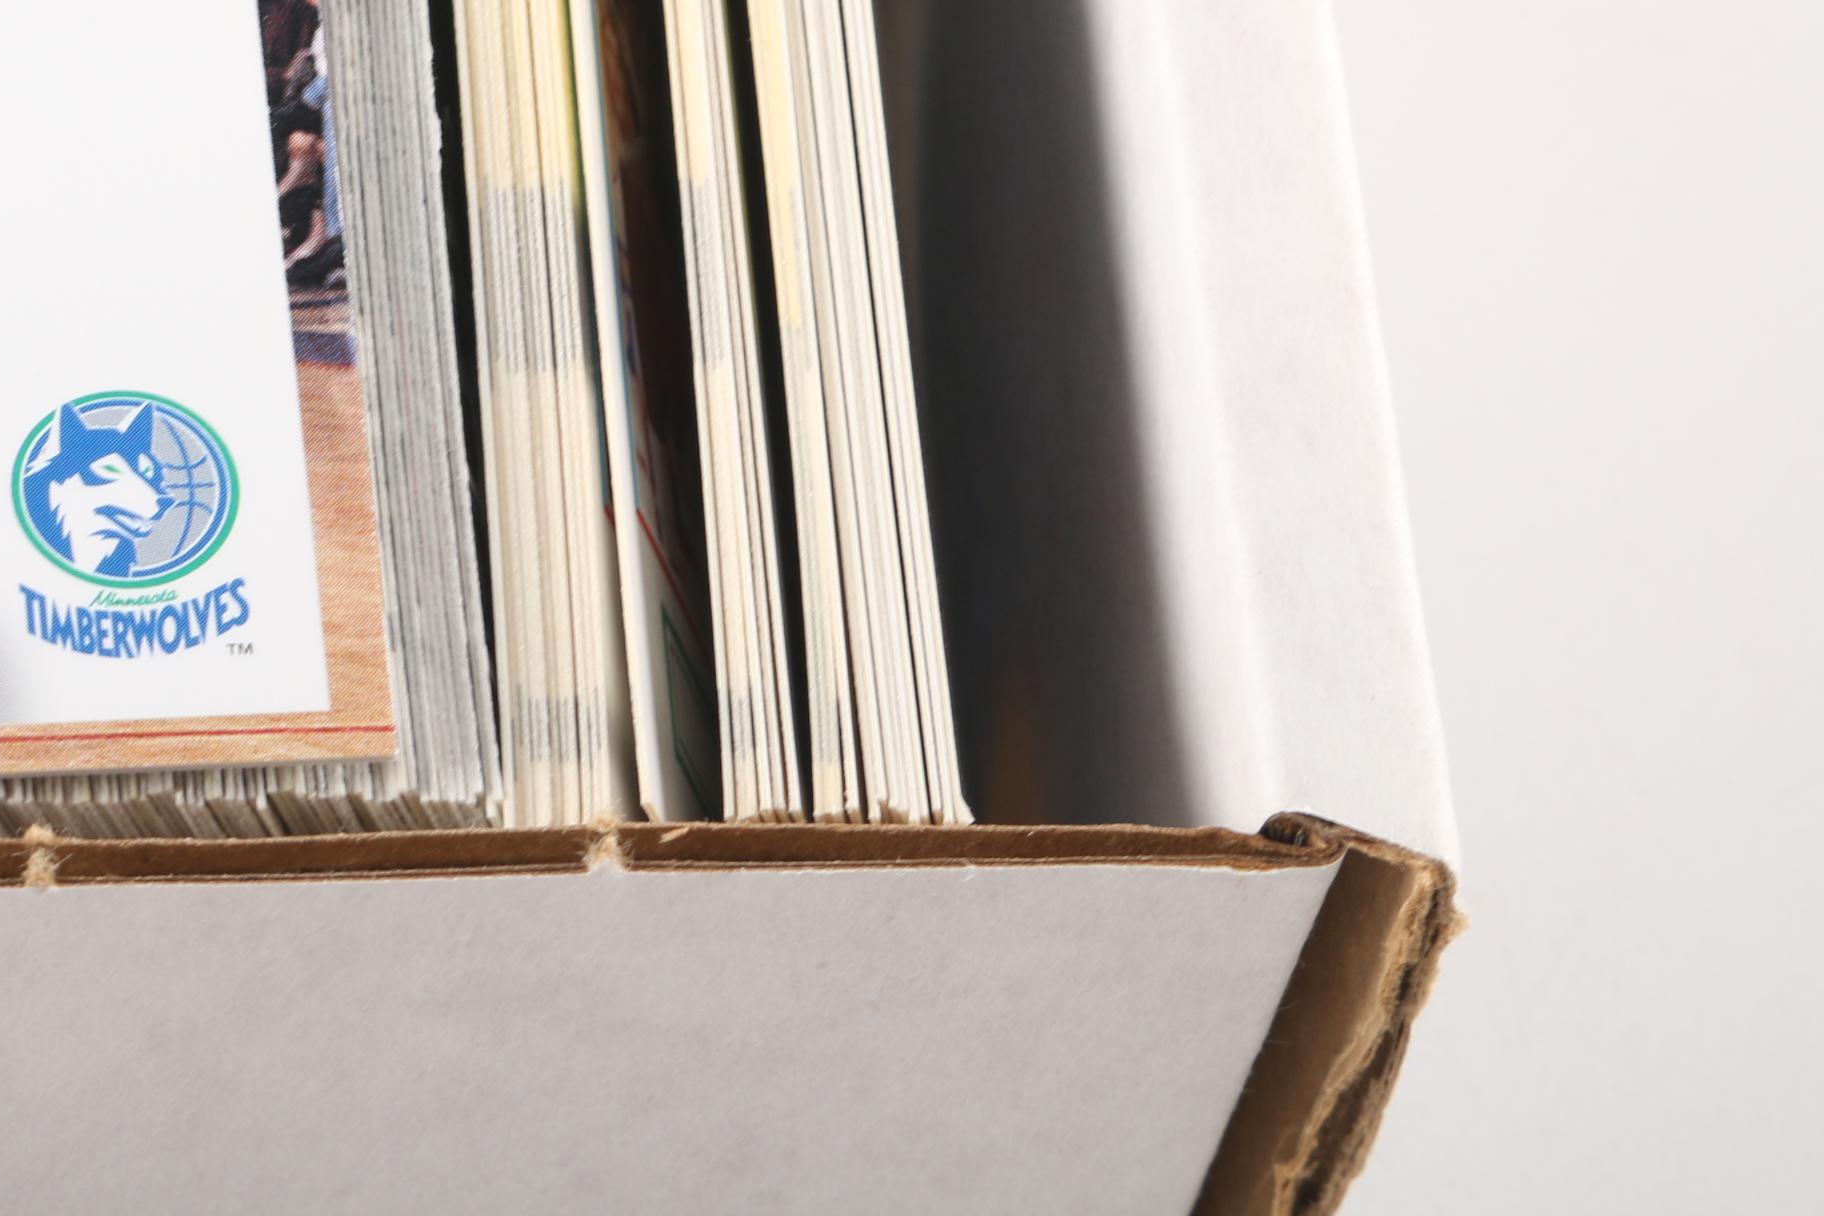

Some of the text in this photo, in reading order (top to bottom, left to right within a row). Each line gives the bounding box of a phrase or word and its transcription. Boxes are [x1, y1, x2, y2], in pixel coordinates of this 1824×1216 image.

[89, 590, 177, 607] Minnesota
[19, 577, 250, 658] TIMBERWOLVES
[227, 642, 254, 656] TM
